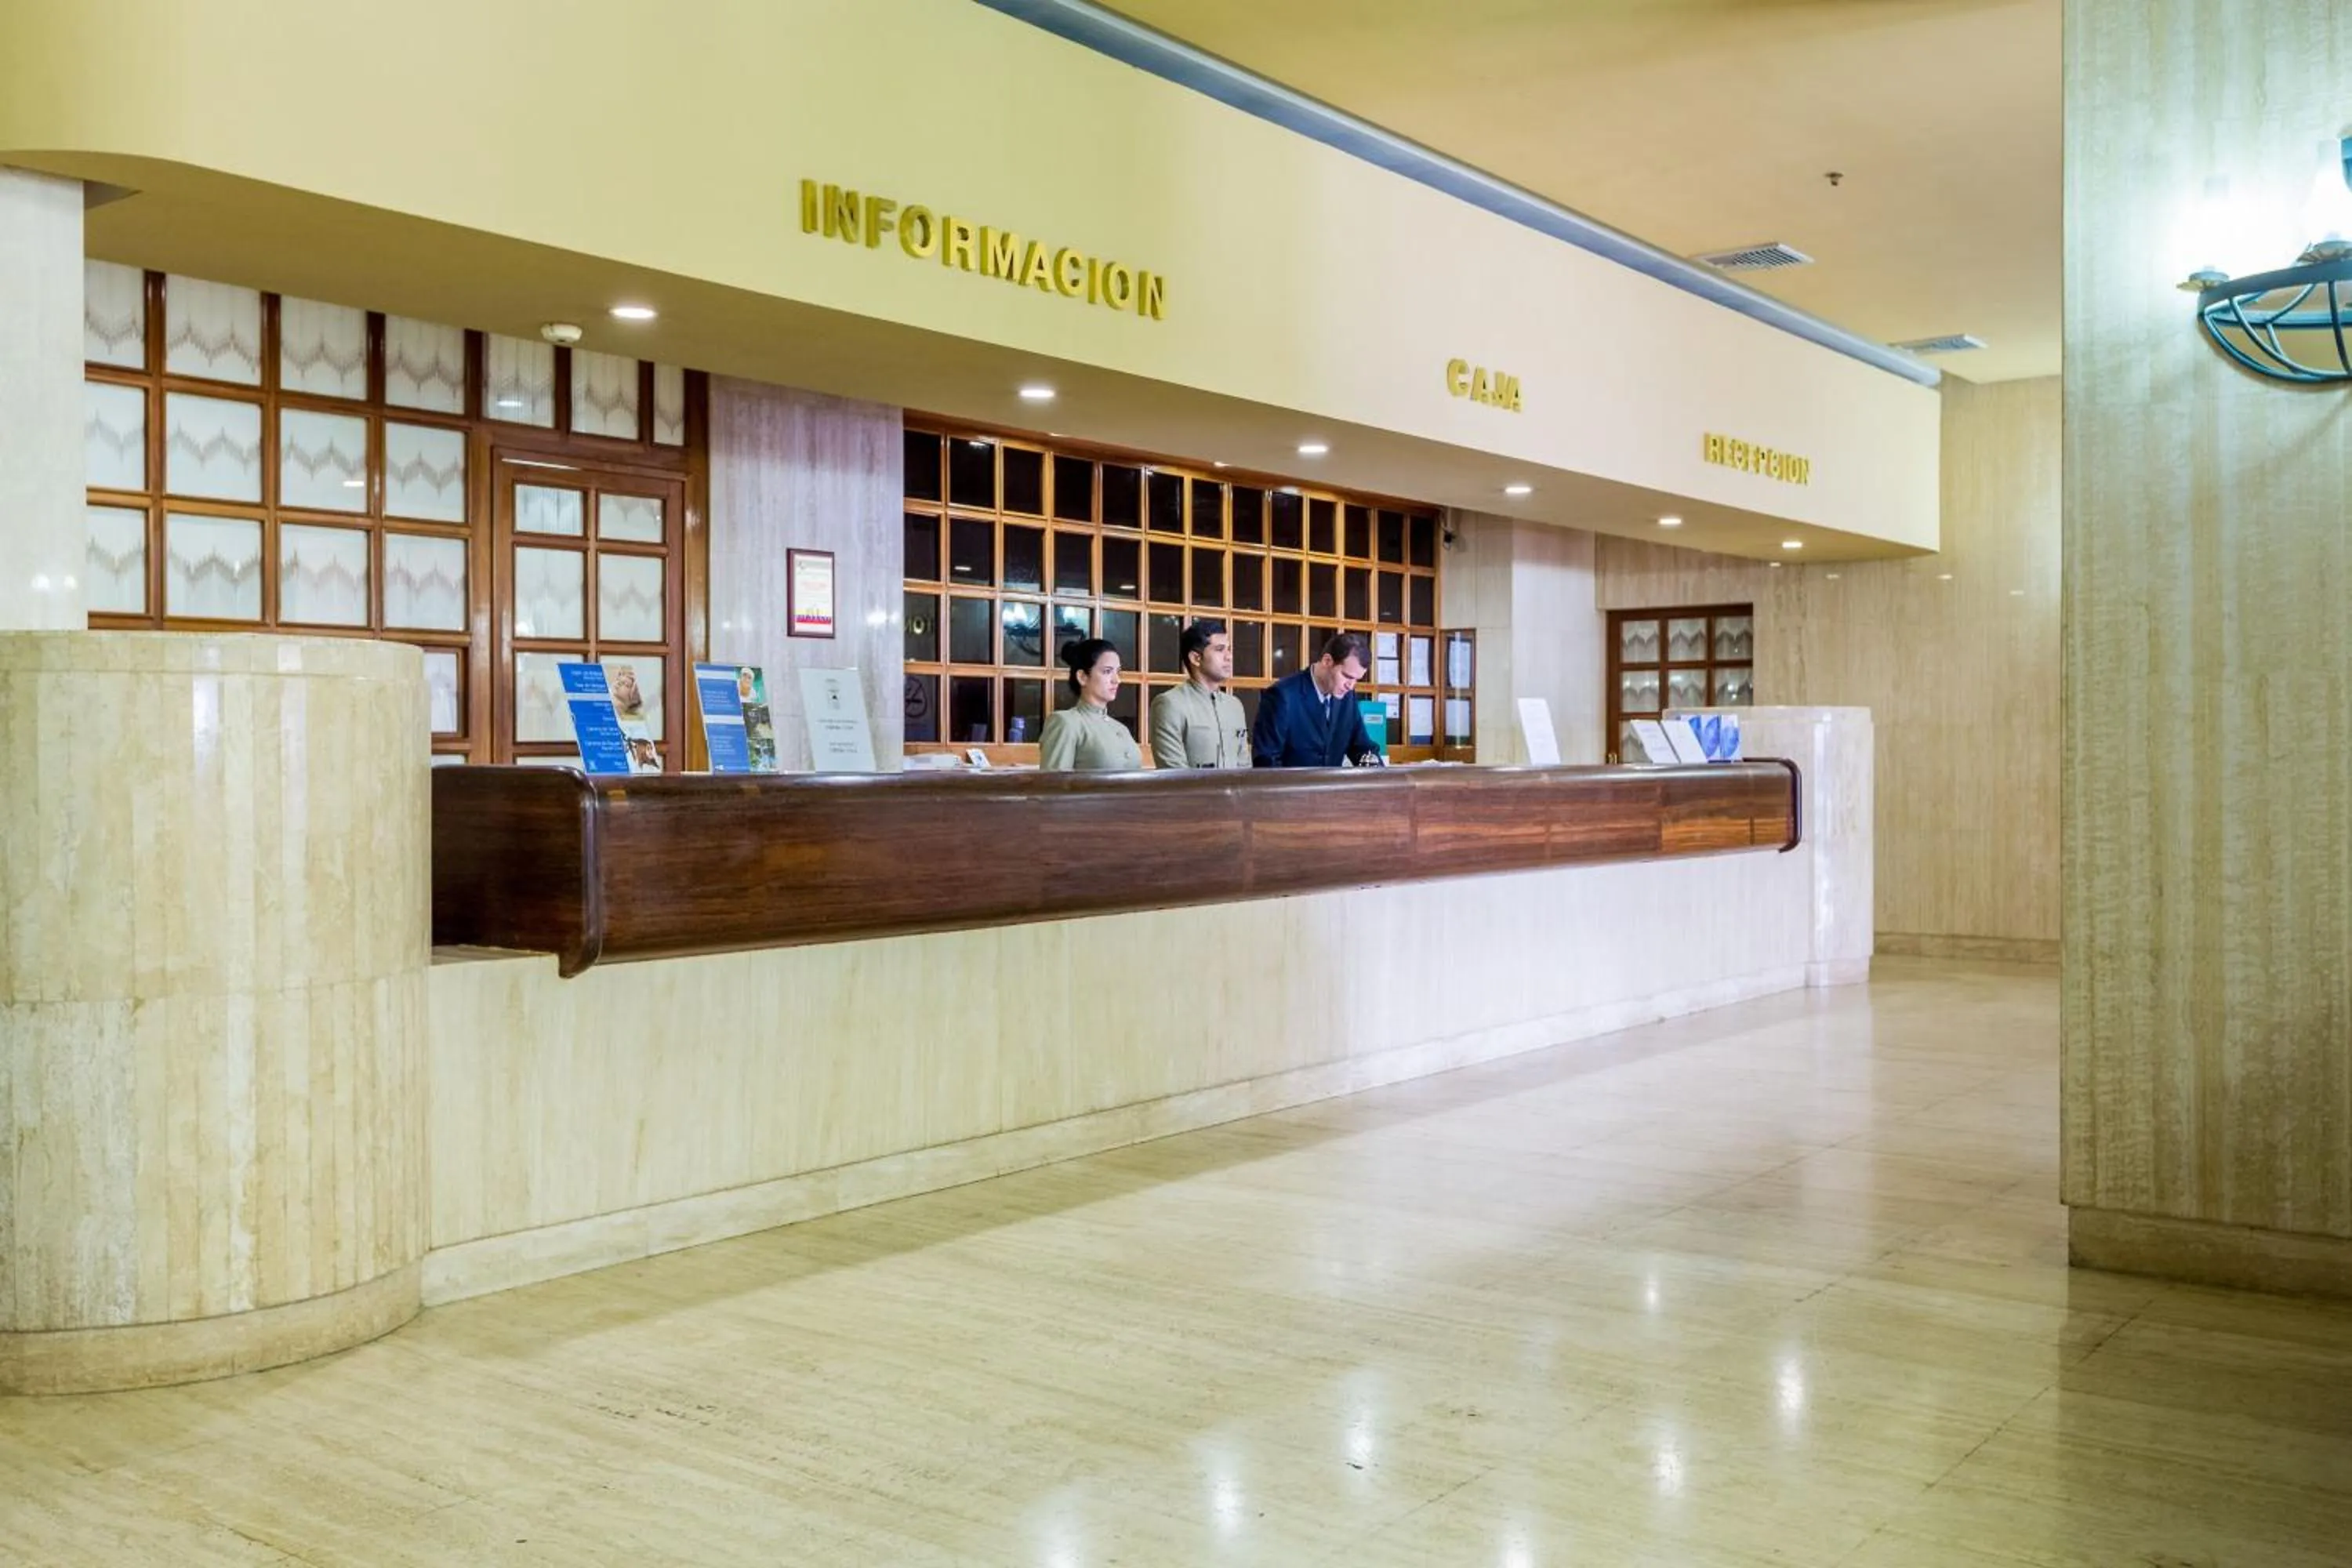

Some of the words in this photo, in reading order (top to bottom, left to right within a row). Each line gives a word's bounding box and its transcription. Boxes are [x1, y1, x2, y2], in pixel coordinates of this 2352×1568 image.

[800, 178, 1167, 320] INFORMACION
[1446, 358, 1522, 412] CAJA
[1703, 432, 1811, 486] RECEPCION
